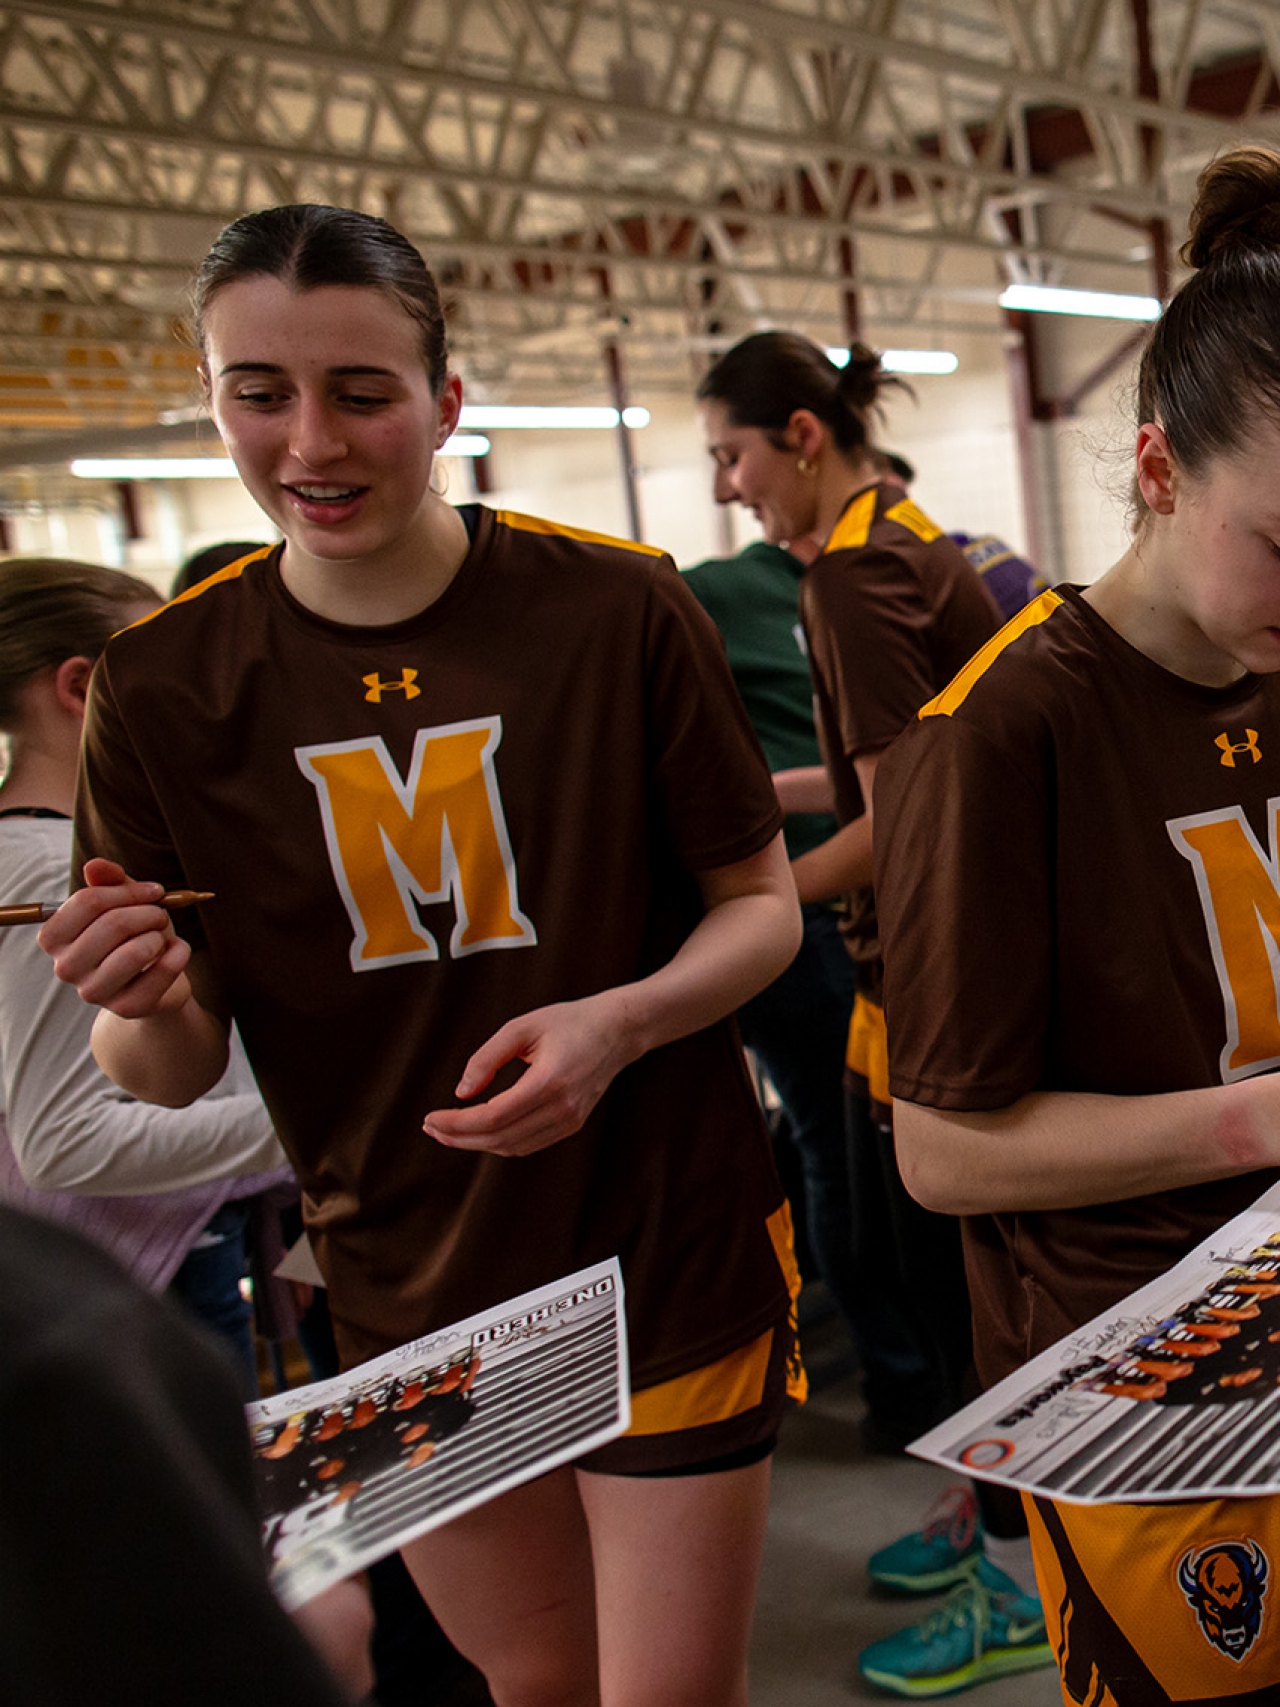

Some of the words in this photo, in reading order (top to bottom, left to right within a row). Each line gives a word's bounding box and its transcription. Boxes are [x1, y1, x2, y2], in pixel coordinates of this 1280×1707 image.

[294, 714, 538, 973] M
[555, 1276, 614, 1313] ONE
[472, 1304, 551, 1348] HERD
[994, 1355, 1108, 1427] Payworks
